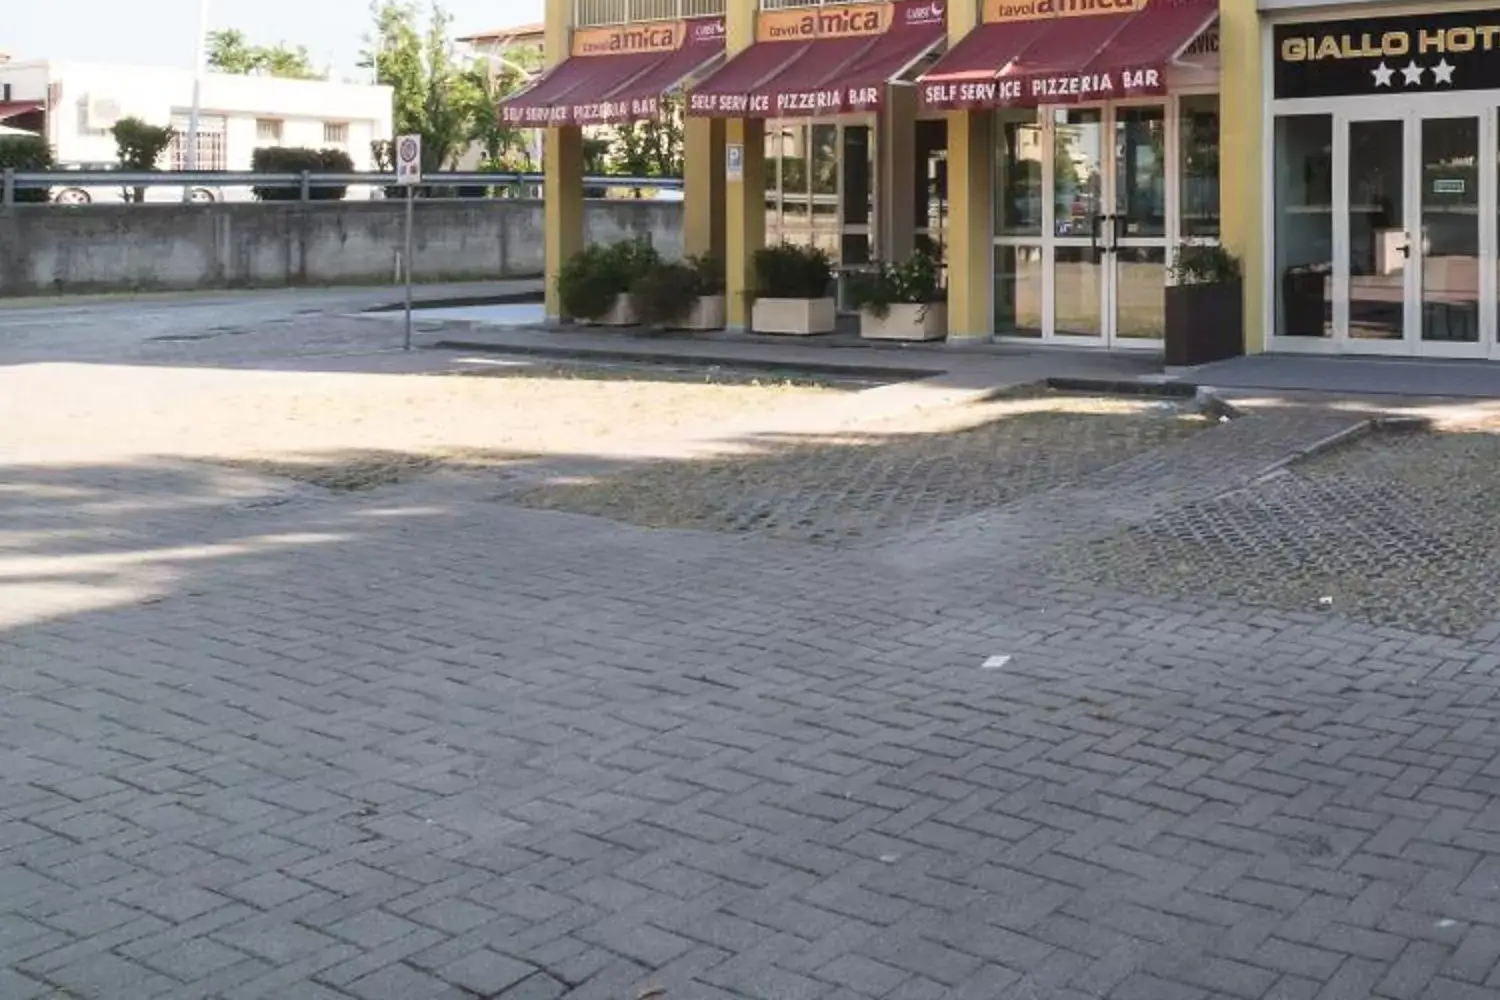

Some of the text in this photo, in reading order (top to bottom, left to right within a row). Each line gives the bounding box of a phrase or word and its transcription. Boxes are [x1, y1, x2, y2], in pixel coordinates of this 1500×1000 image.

[1281, 31, 1409, 61] GIALLO
[925, 68, 1159, 103] SELF SERVICE PIZZERIA BAR
[525, 104, 567, 121] SERVICE
[573, 102, 627, 120] PIZZERIA
[632, 98, 657, 116] BAR
[691, 87, 877, 112] SELF SERVICE PIZZERIA BAR
